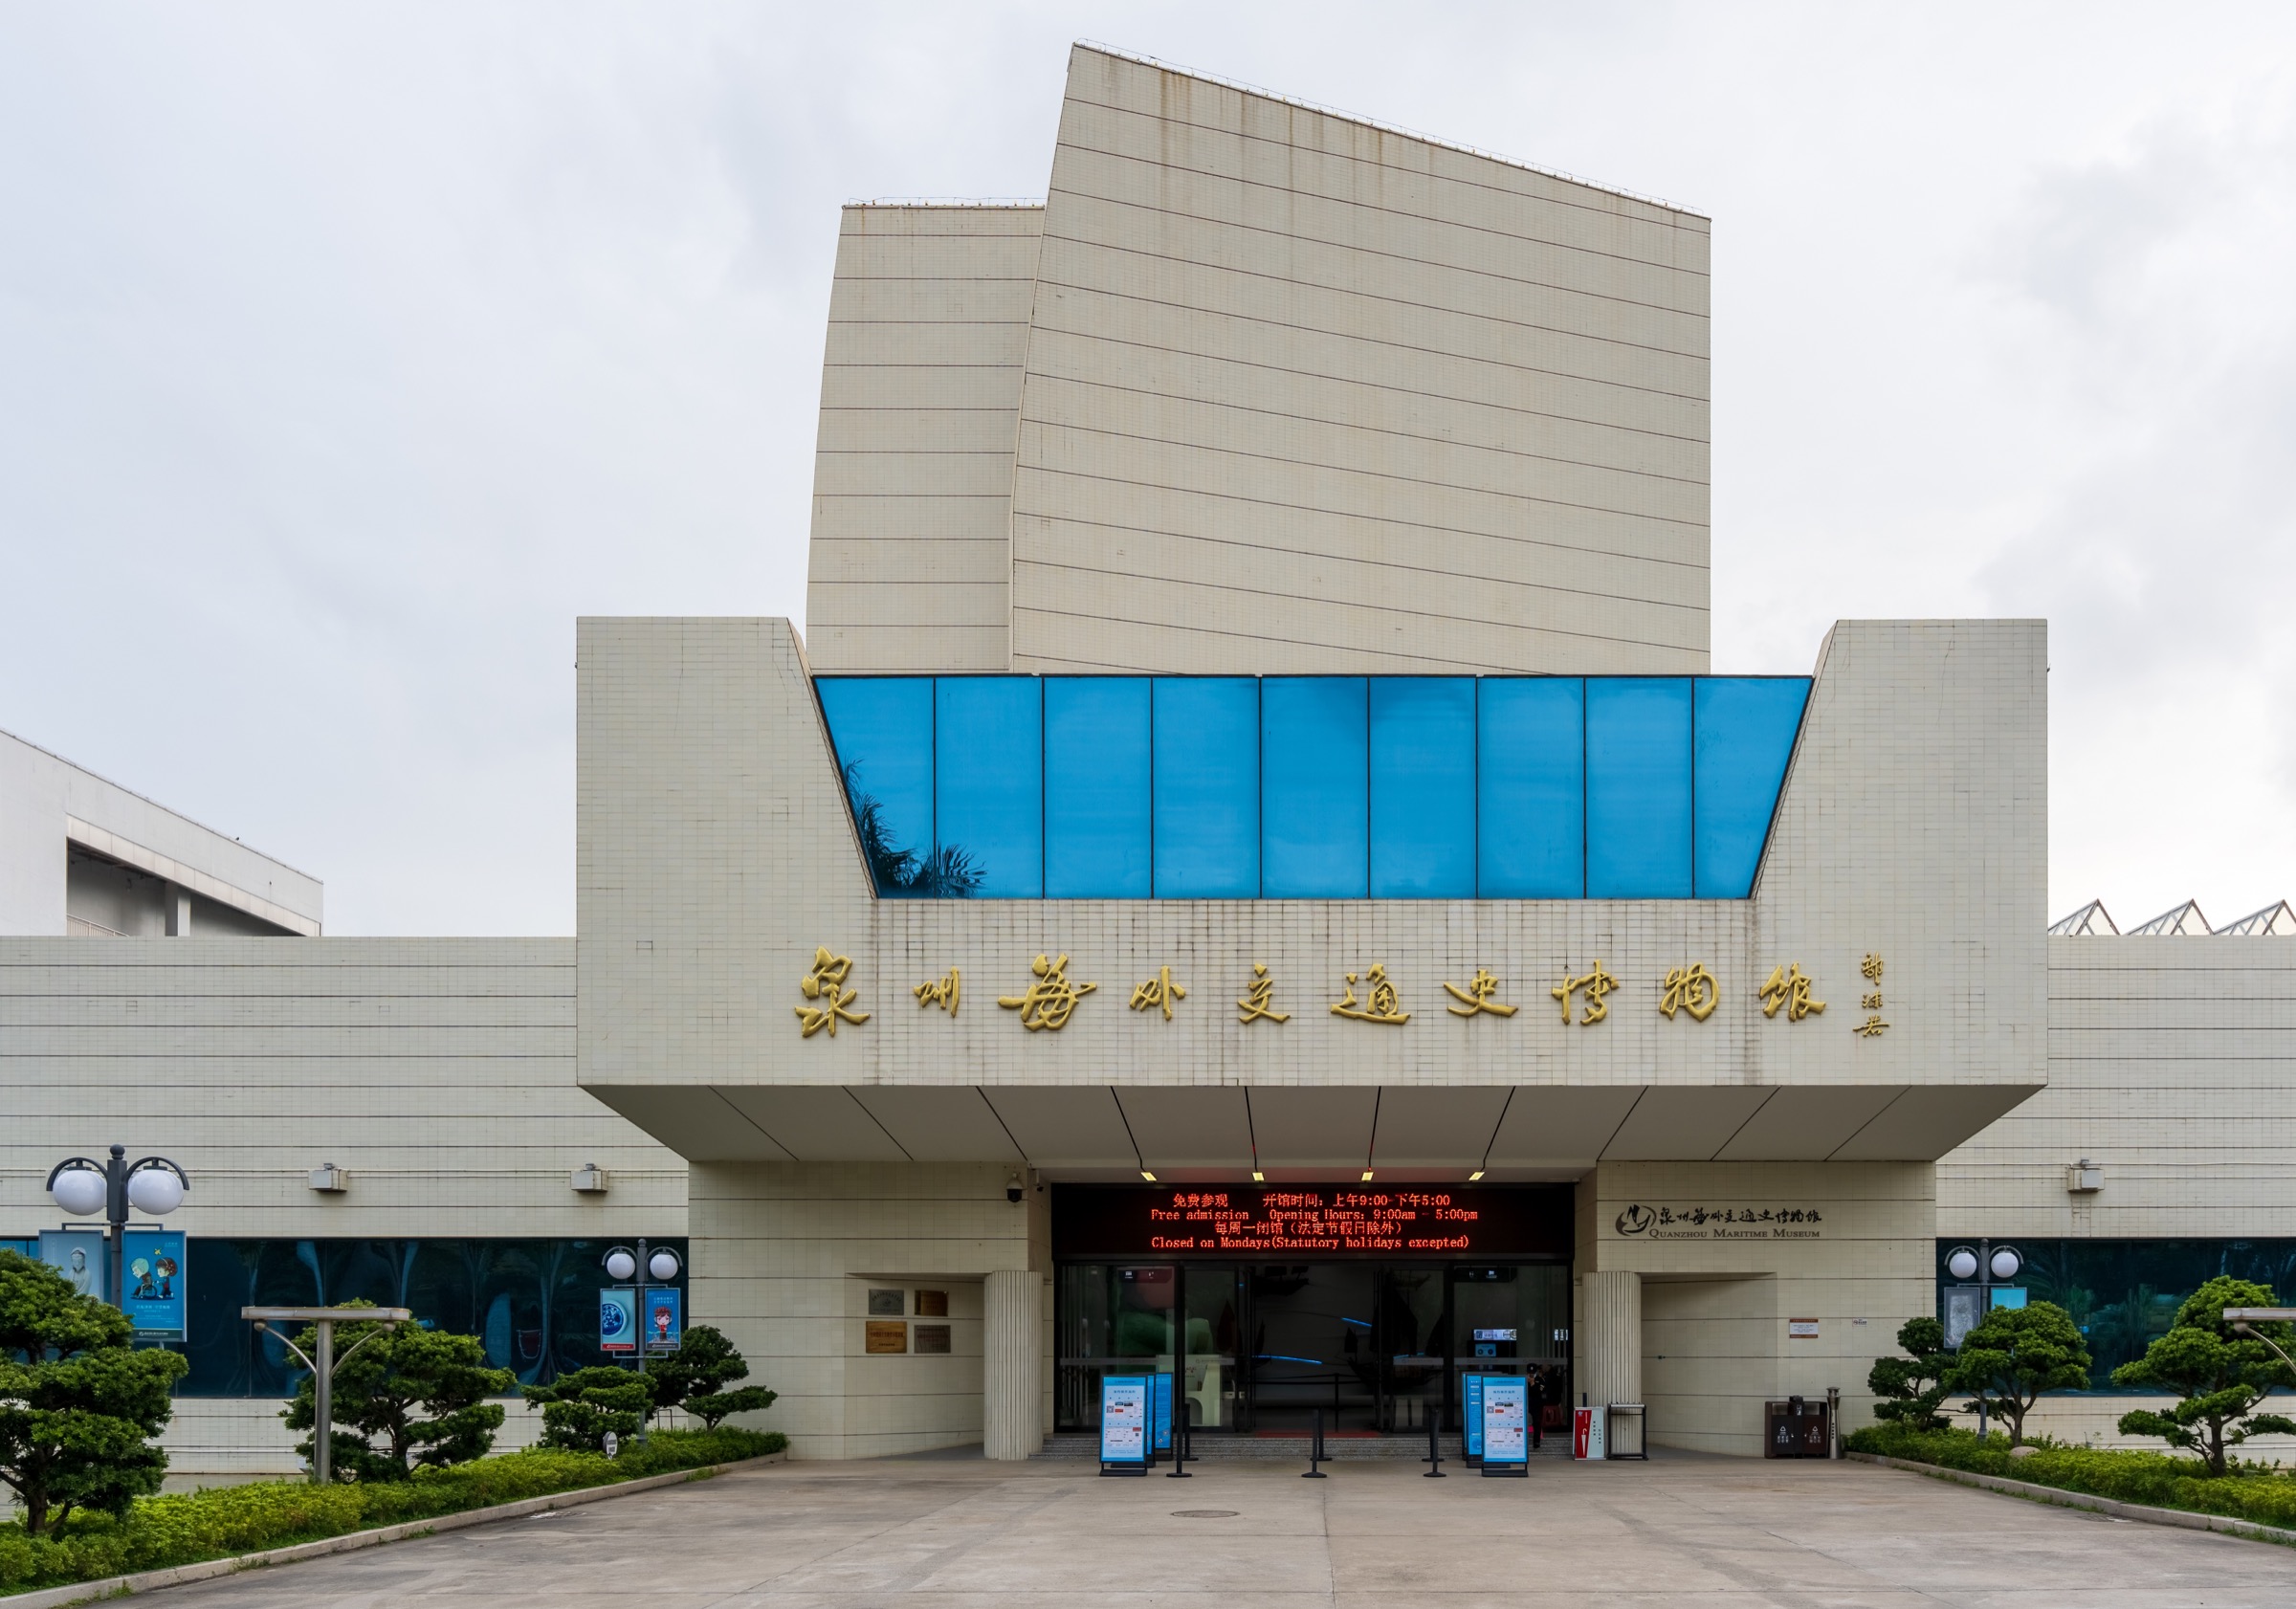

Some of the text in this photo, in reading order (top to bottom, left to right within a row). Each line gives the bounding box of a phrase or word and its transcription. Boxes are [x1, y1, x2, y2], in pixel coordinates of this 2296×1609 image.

[1173, 1193, 1228, 1207] 免费参观
[1151, 1209, 1181, 1220] Free
[1186, 1209, 1249, 1220] admission
[1269, 1209, 1319, 1223] Opening
[1373, 1209, 1416, 1220] 9:00am
[1435, 1209, 1478, 1222] 5:00pm
[1151, 1236, 1194, 1248] Closed
[1200, 1239, 1214, 1248] on
[1346, 1236, 1402, 1249] holidays
[1408, 1235, 1469, 1249] excepted)
